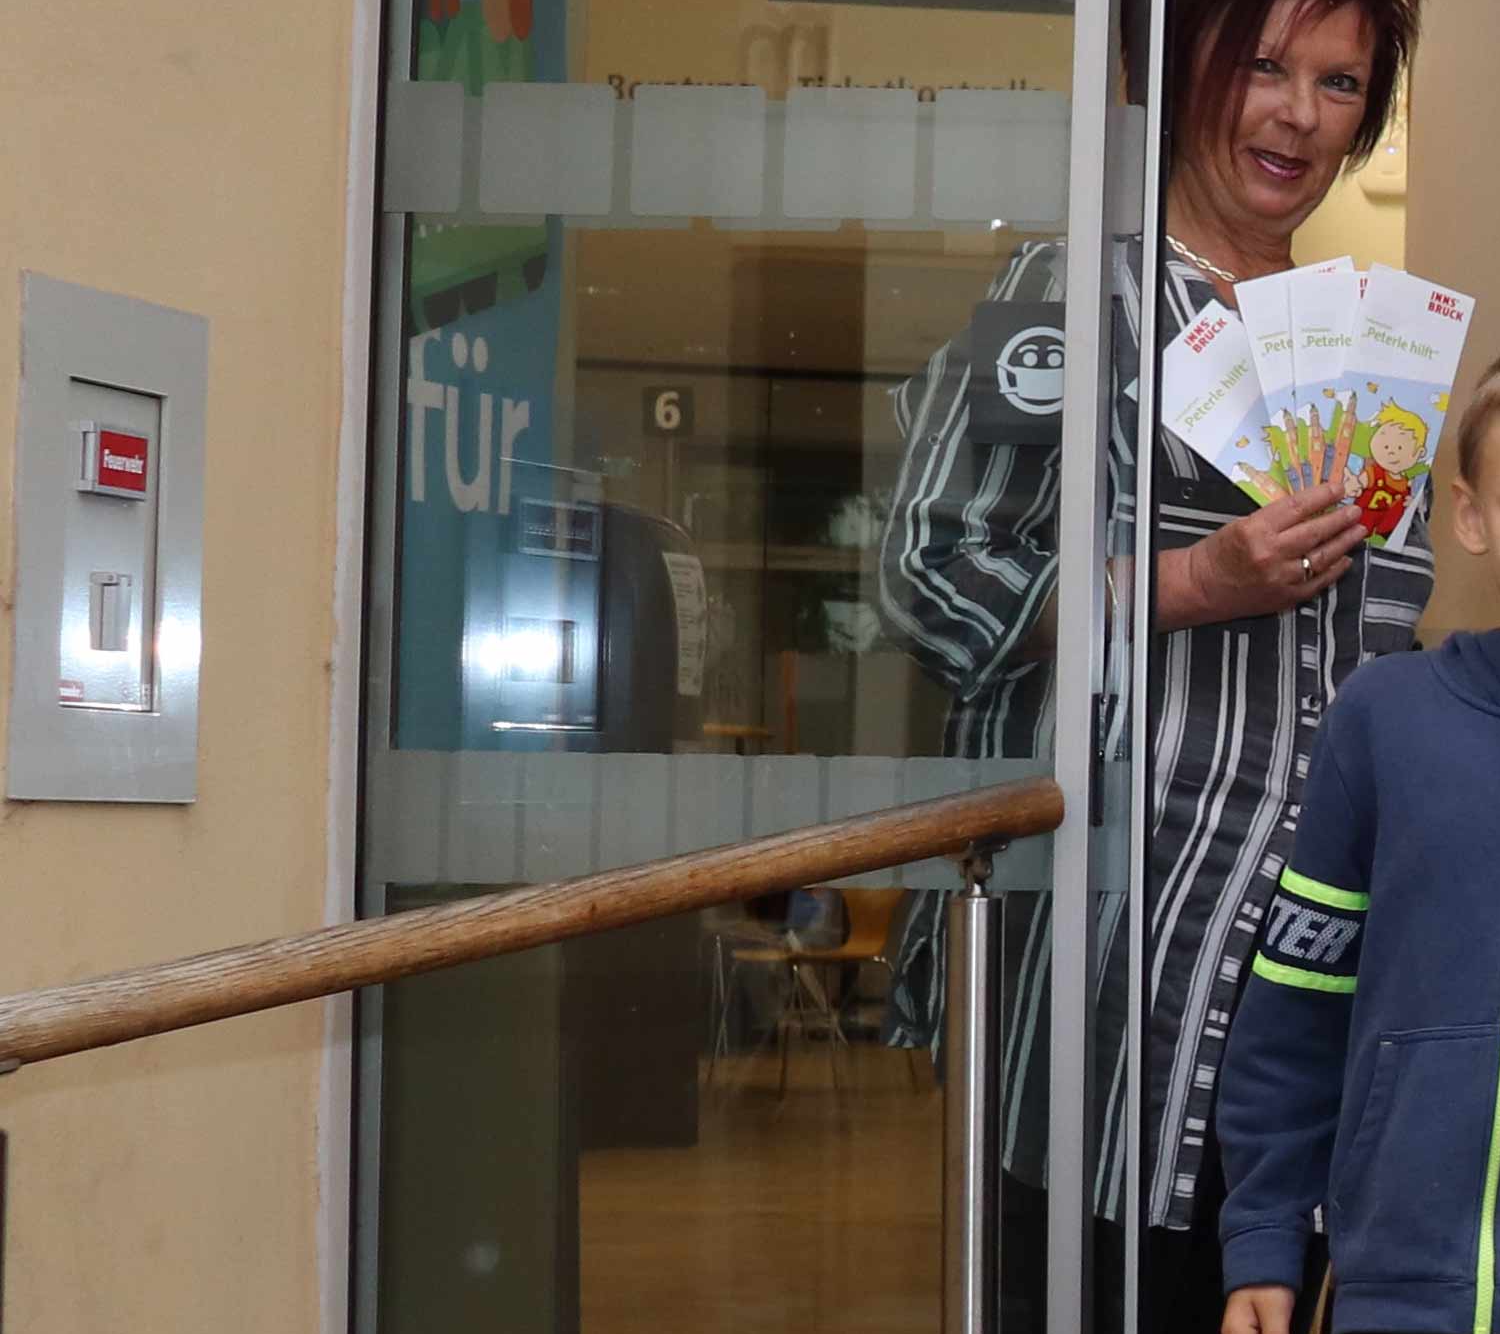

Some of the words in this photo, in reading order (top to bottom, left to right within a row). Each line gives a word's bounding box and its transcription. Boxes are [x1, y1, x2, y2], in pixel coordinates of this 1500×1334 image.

[1427, 301, 1464, 322] BRUCK
[1191, 317, 1229, 355] BRUCK
[407, 326, 530, 516] für
[655, 390, 682, 431] 6
[1266, 894, 1360, 964] TER
